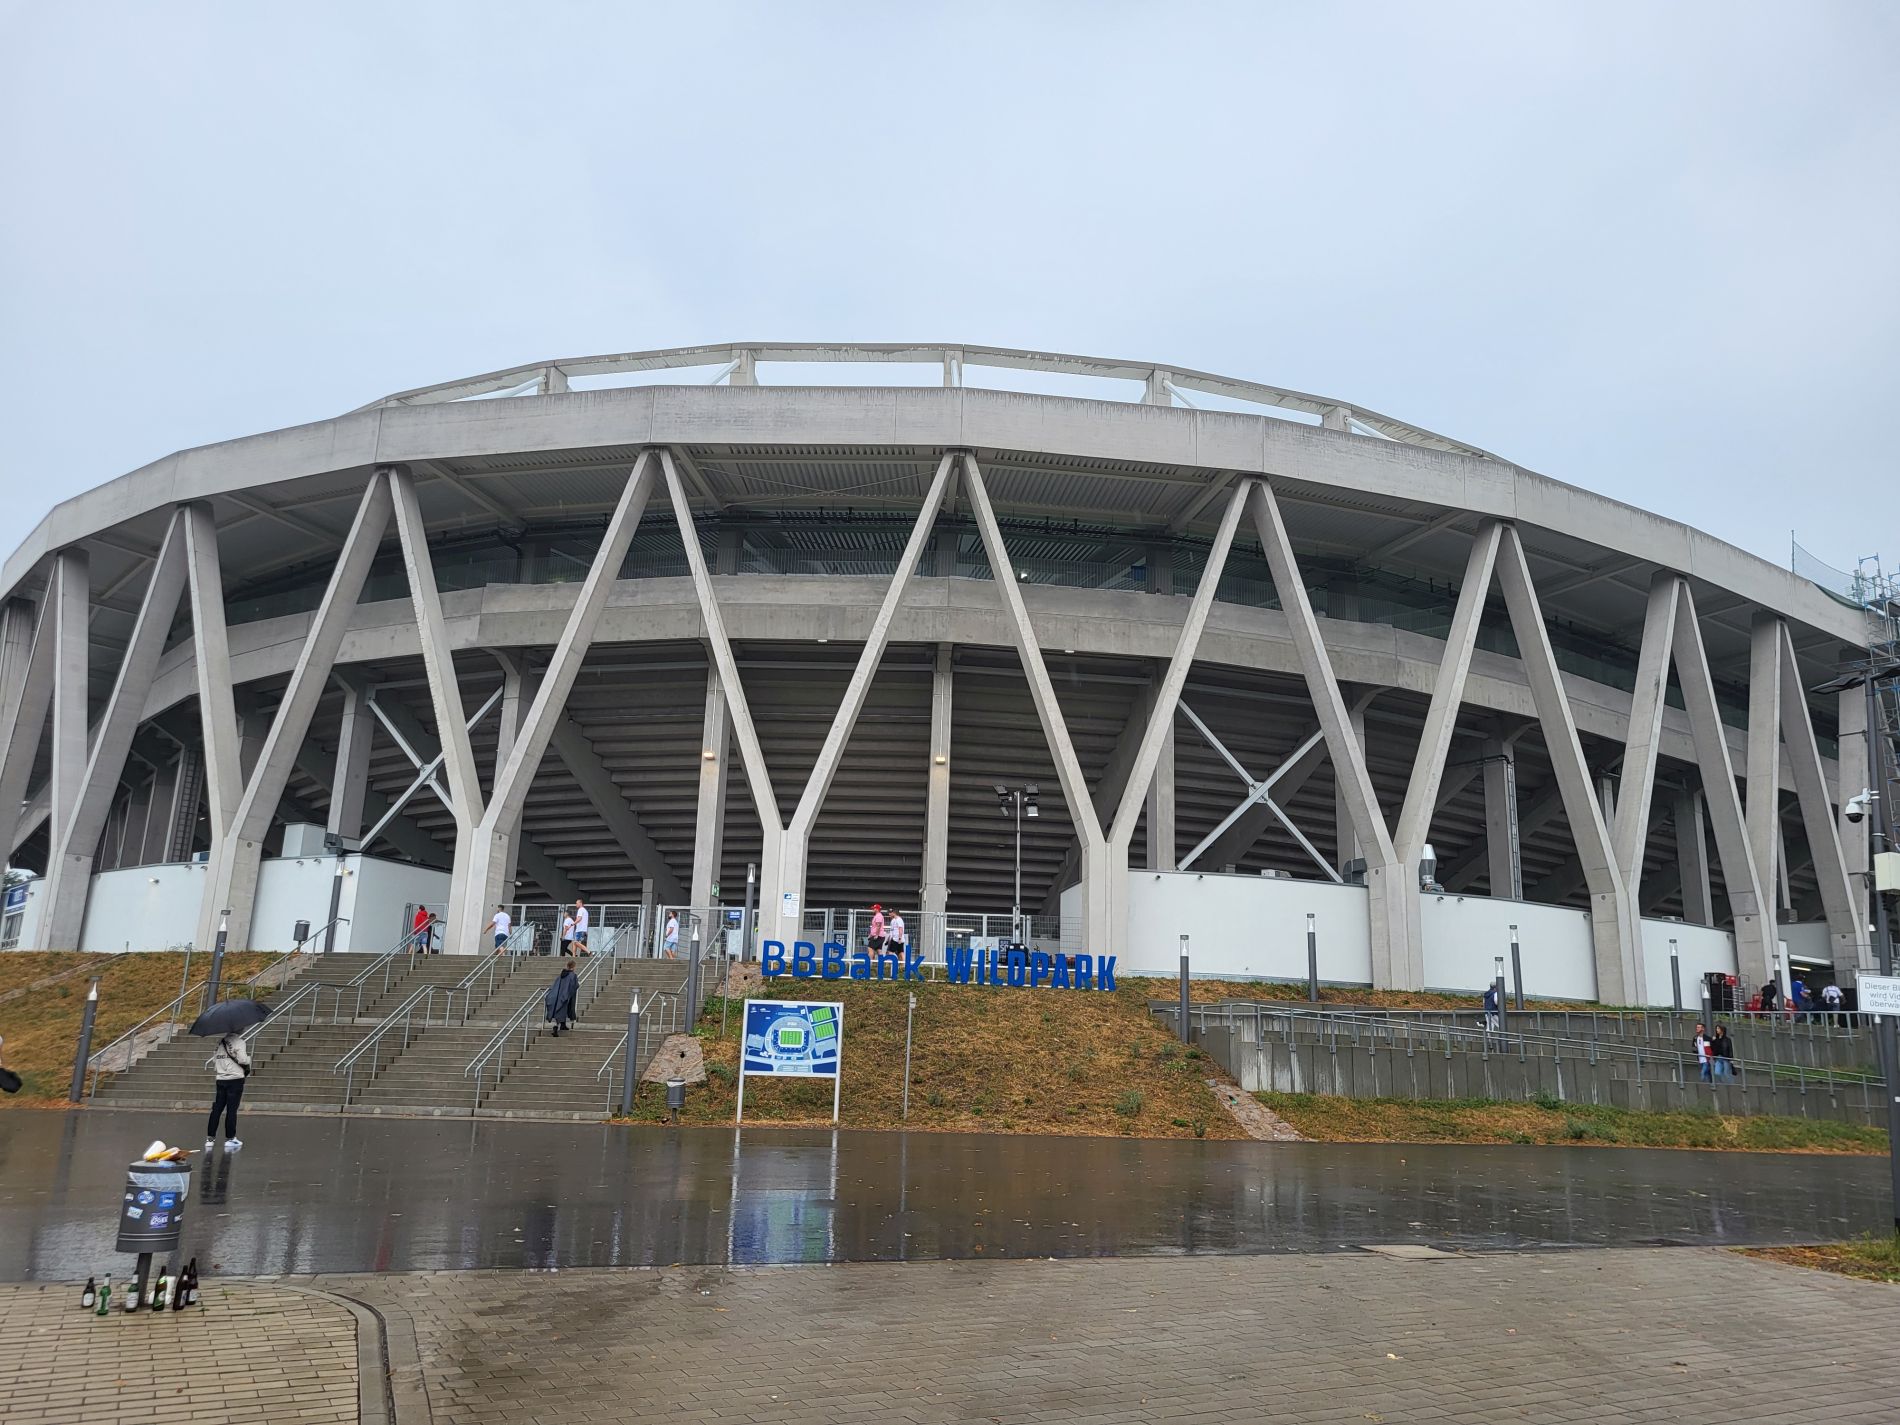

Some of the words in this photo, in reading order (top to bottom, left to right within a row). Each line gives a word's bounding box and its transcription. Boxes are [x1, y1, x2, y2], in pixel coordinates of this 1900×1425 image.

[761, 940, 925, 982] BBBank
[945, 947, 1117, 991] WILDPARK
[1864, 982, 1890, 990] Dieser
[1869, 991, 1887, 999] wird
